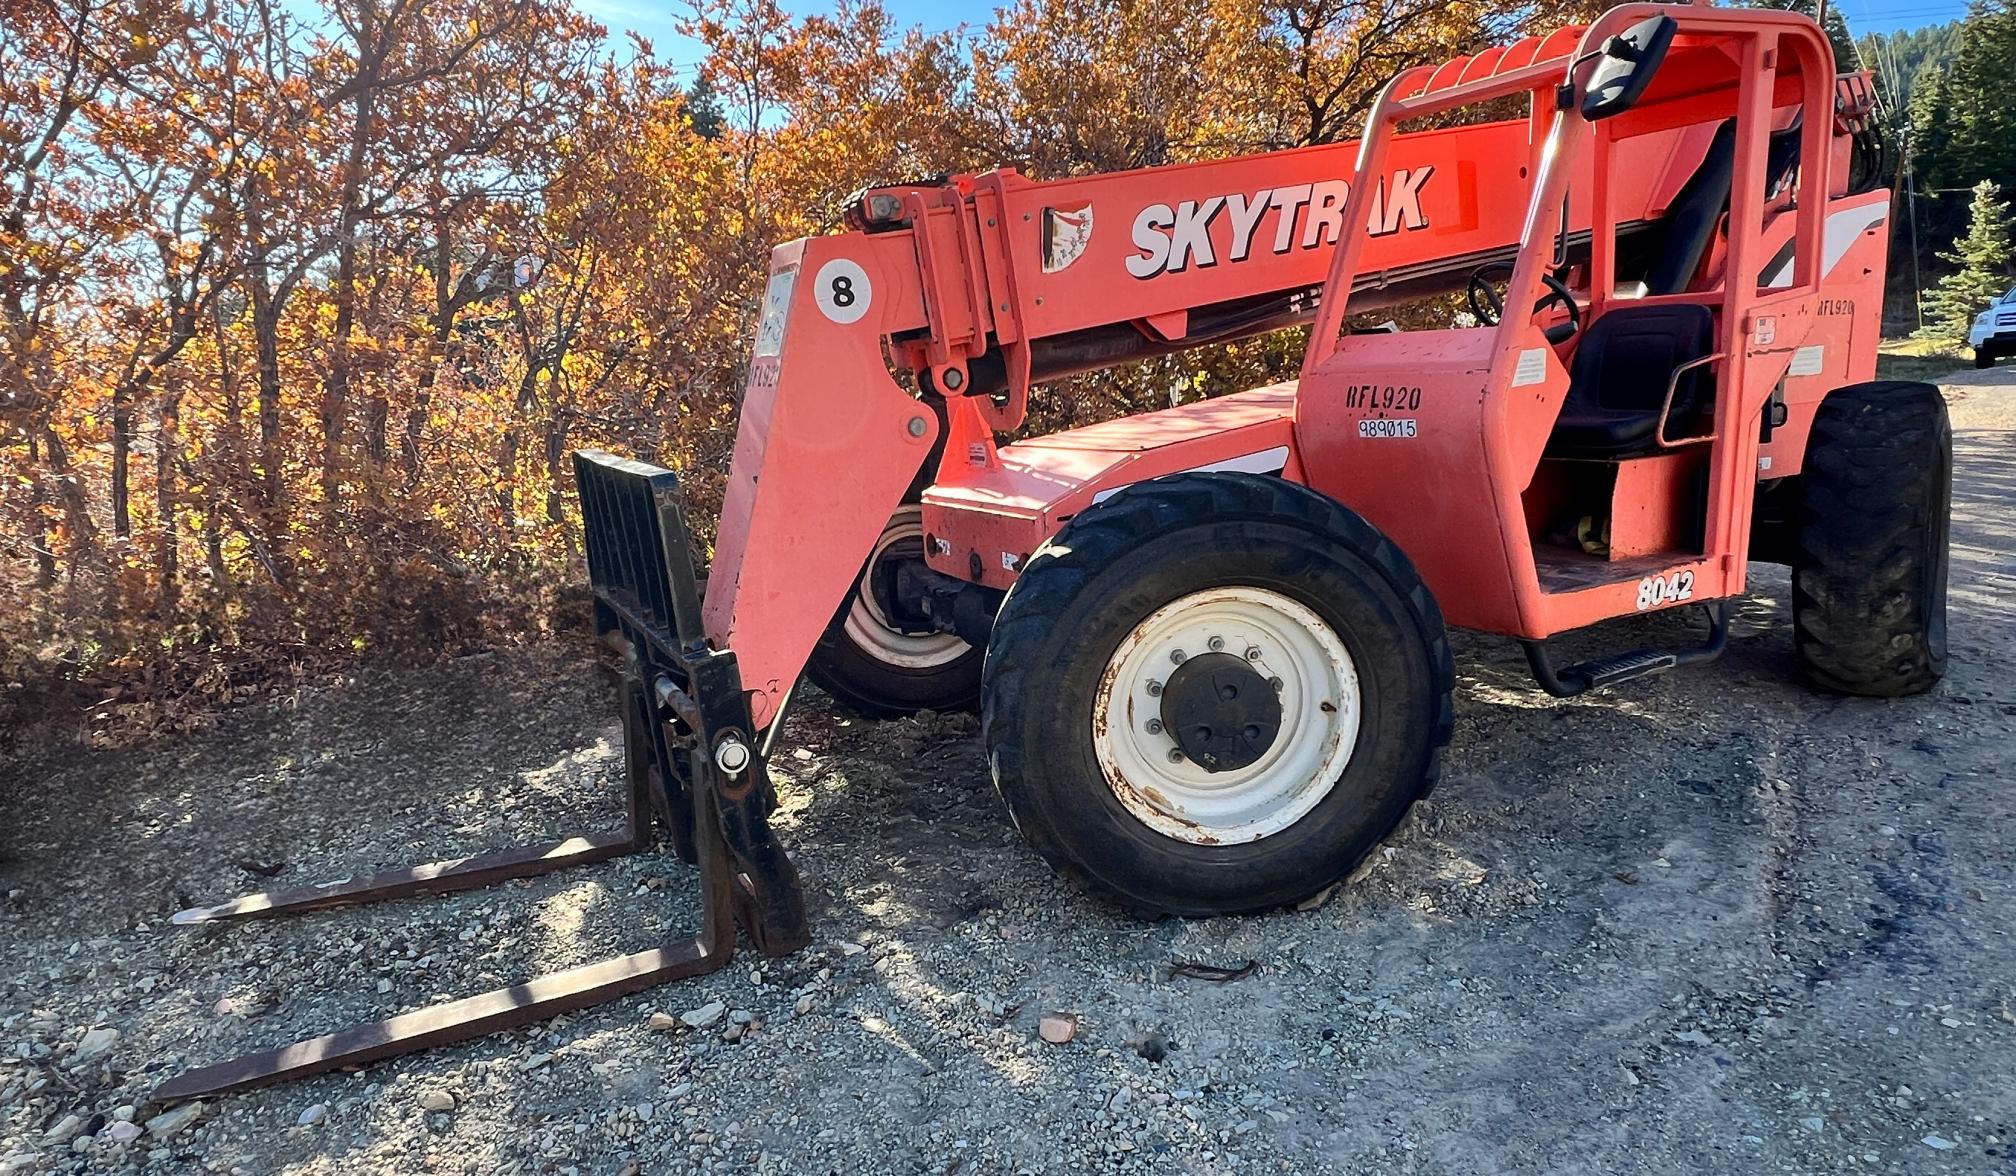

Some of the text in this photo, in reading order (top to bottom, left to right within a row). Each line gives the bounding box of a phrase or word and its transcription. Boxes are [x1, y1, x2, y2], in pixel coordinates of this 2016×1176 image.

[832, 276, 855, 307] 8
[1345, 385, 1422, 411] RFL920
[1359, 420, 1417, 437] 989015
[1636, 569, 1695, 610] 8042
